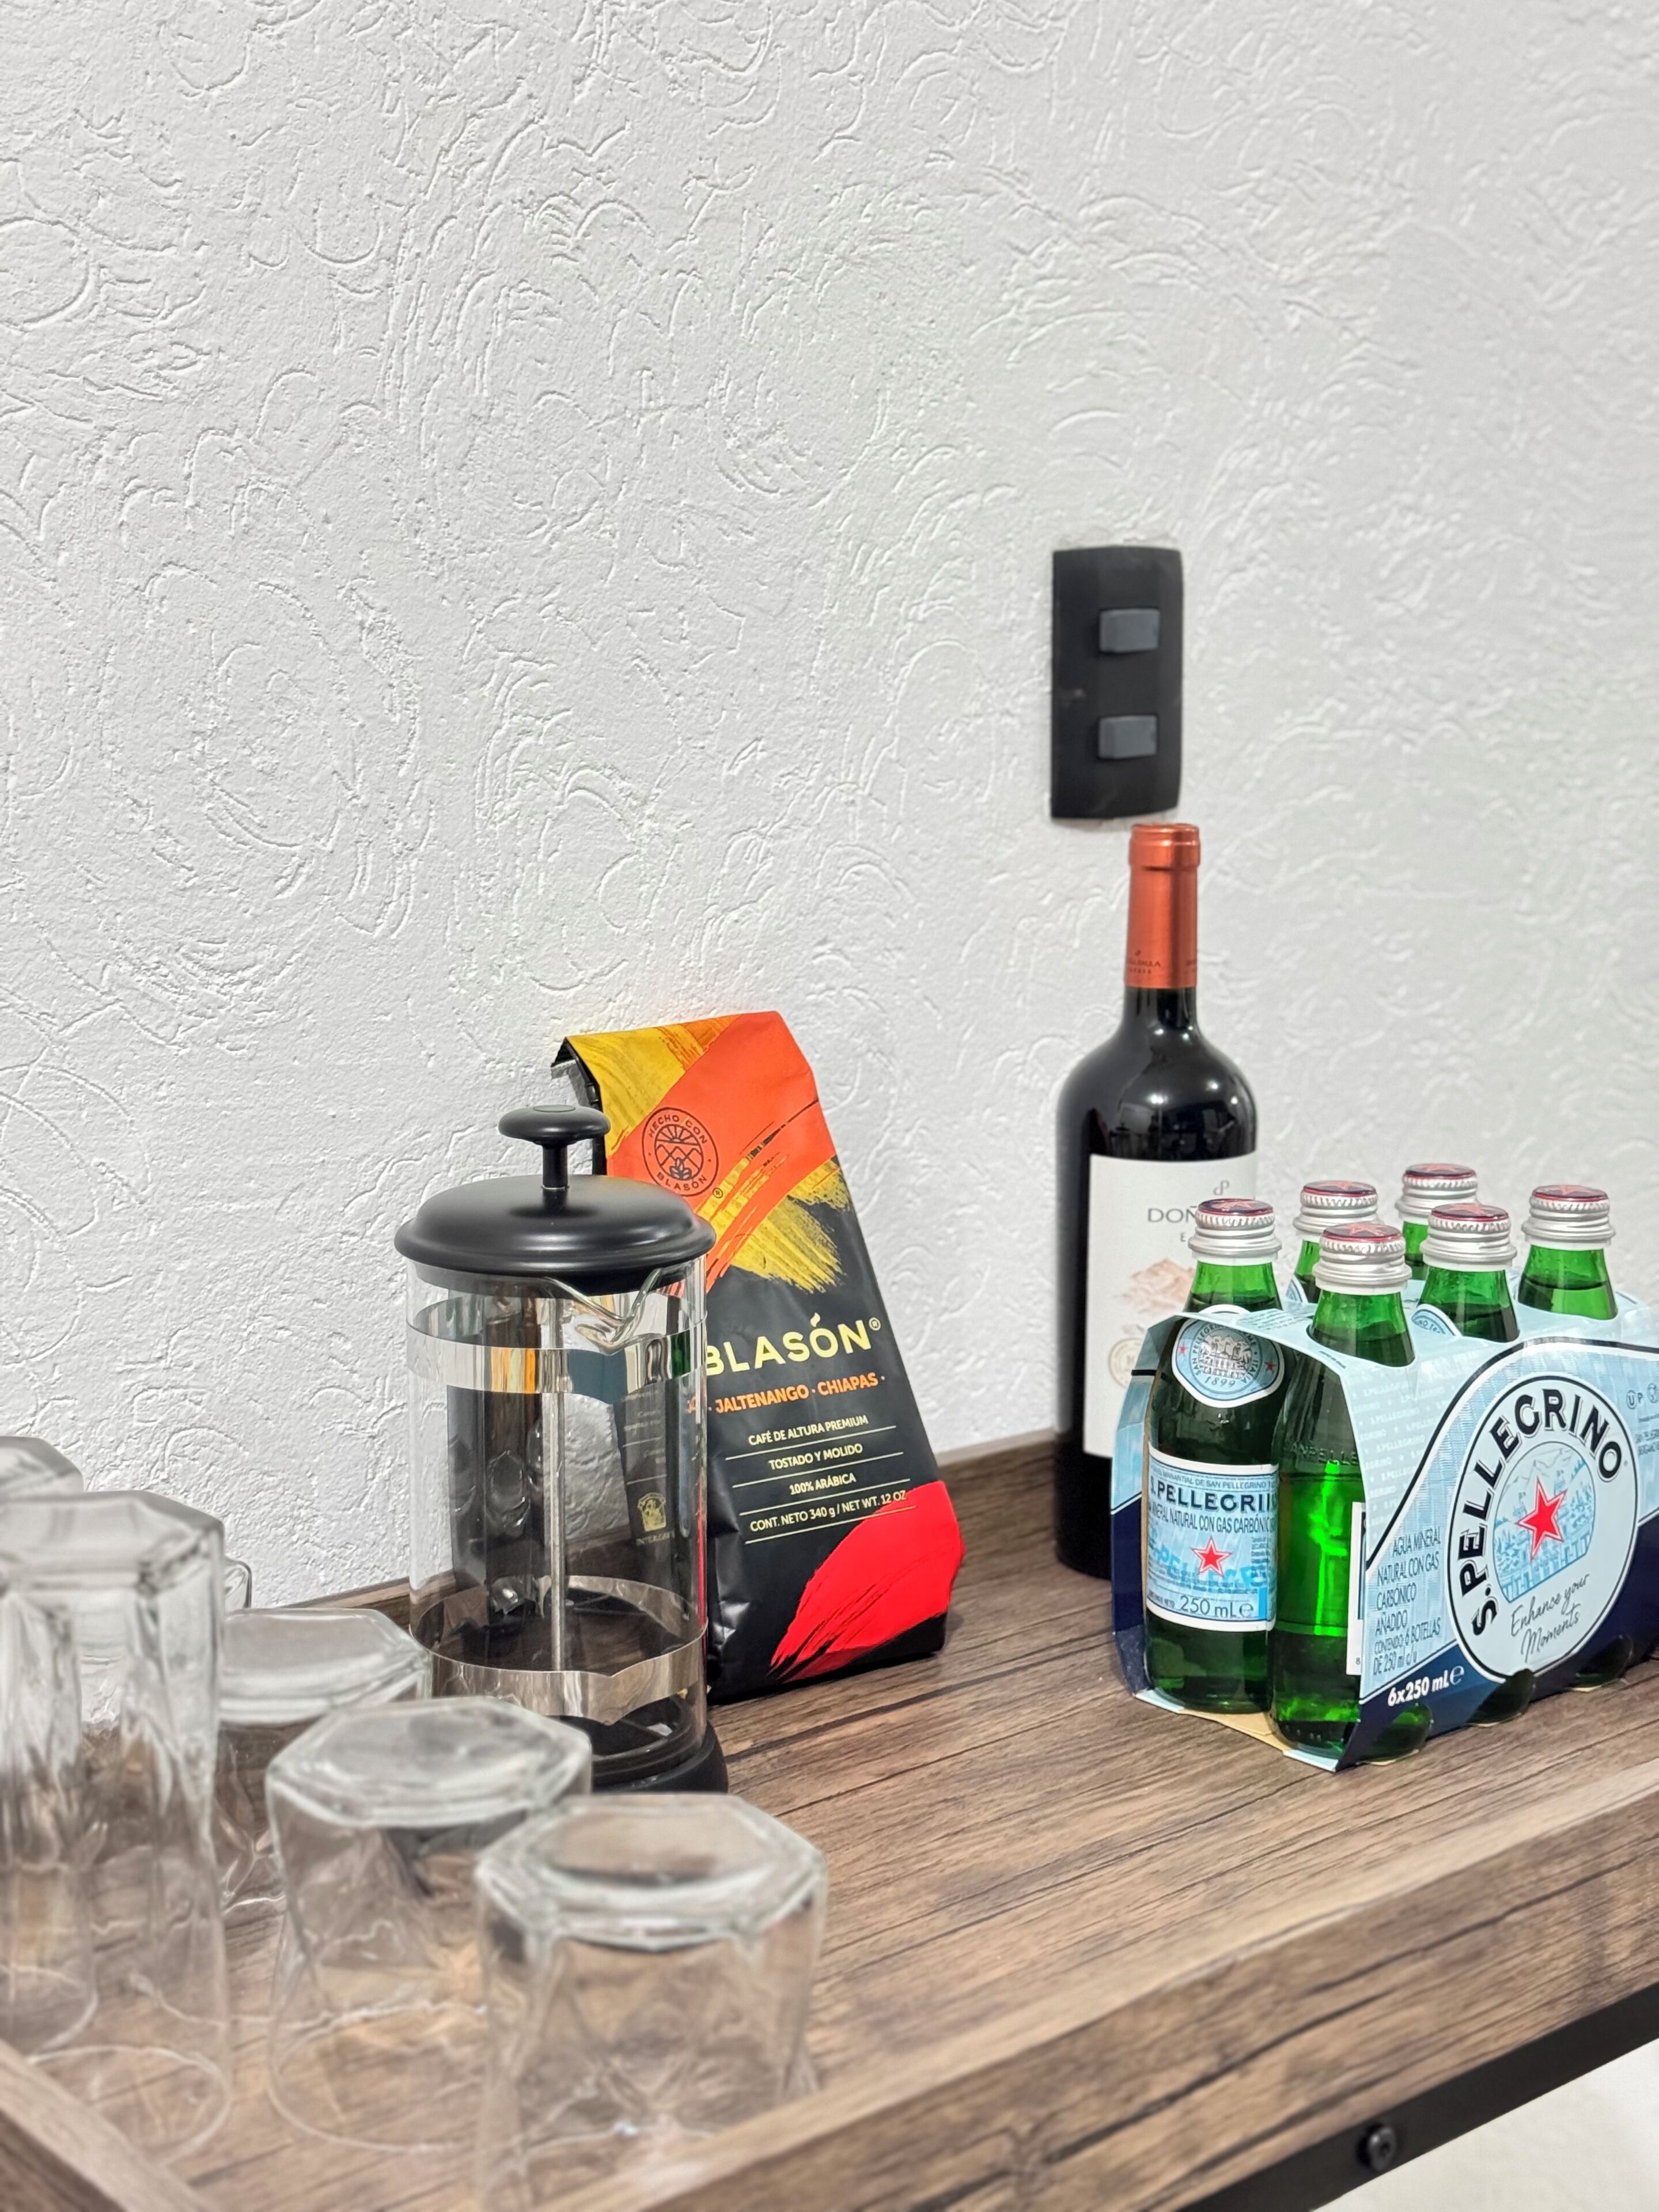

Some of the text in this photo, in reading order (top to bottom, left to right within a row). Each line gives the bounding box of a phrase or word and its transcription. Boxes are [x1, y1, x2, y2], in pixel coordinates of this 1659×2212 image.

[649, 1114, 708, 1145] HECHO CON
[715, 1384, 809, 1414] JALTENANGO
[817, 1372, 879, 1396] CHIAPAS
[1205, 1376, 1236, 1388] 1899
[748, 1415, 869, 1446] CAFÉ DE ALTURA PREMIUM
[768, 1443, 863, 1470] TOSTADO Y MOLIDO
[789, 1472, 857, 1496] 100% ARÁBICA
[1206, 1480, 1221, 1488] SAN
[1222, 1481, 1267, 1490] PELLEGRINO
[749, 1518, 781, 1532] CONT.
[781, 1512, 809, 1527] NETO
[809, 1506, 828, 1520] 340
[828, 1507, 836, 1518] g
[842, 1500, 860, 1513] NET
[862, 1495, 881, 1509] WT.
[881, 1493, 892, 1505] 12
[893, 1490, 907, 1502] OZ
[1169, 1506, 1198, 1531] NATURAL
[1199, 1514, 1215, 1532] CON
[1217, 1517, 1232, 1534] GAS
[1458, 1388, 1623, 1637] S.PELLEGRINO
[1392, 1526, 1441, 1557] AGUA MINERAL
[1377, 1551, 1440, 1586] NATURAL CON GAS
[1180, 1594, 1210, 1615] 250
[1510, 1573, 1591, 1637] Enhance your
[1376, 1609, 1408, 1637] AÑADIDO
[1411, 1617, 1441, 1643] BOTELLAS
[1520, 1603, 1581, 1664] Moments
[1387, 1676, 1430, 1707] 6x250
